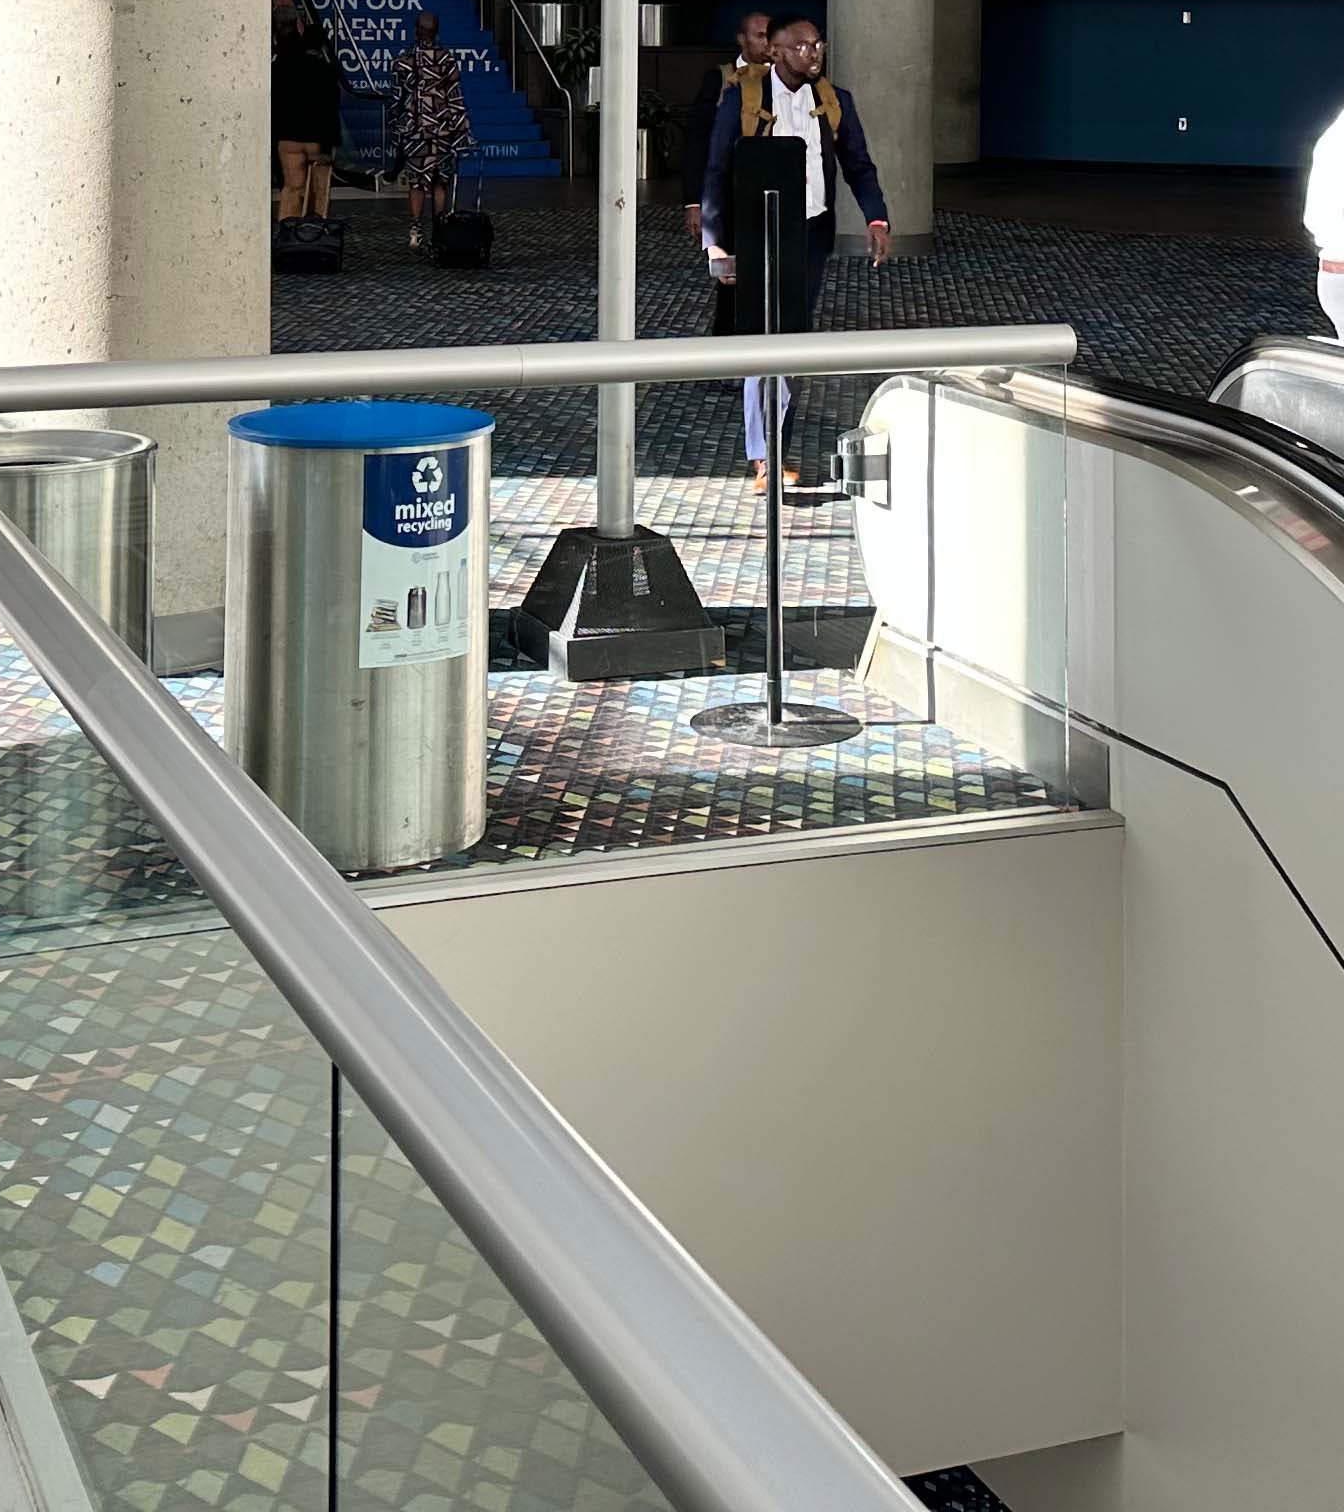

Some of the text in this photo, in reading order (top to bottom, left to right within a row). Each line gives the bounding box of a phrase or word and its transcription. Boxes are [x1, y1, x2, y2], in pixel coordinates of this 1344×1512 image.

[323, 18, 406, 41] ALENT
[394, 493, 456, 521] mixed
[396, 515, 453, 535] recycling
